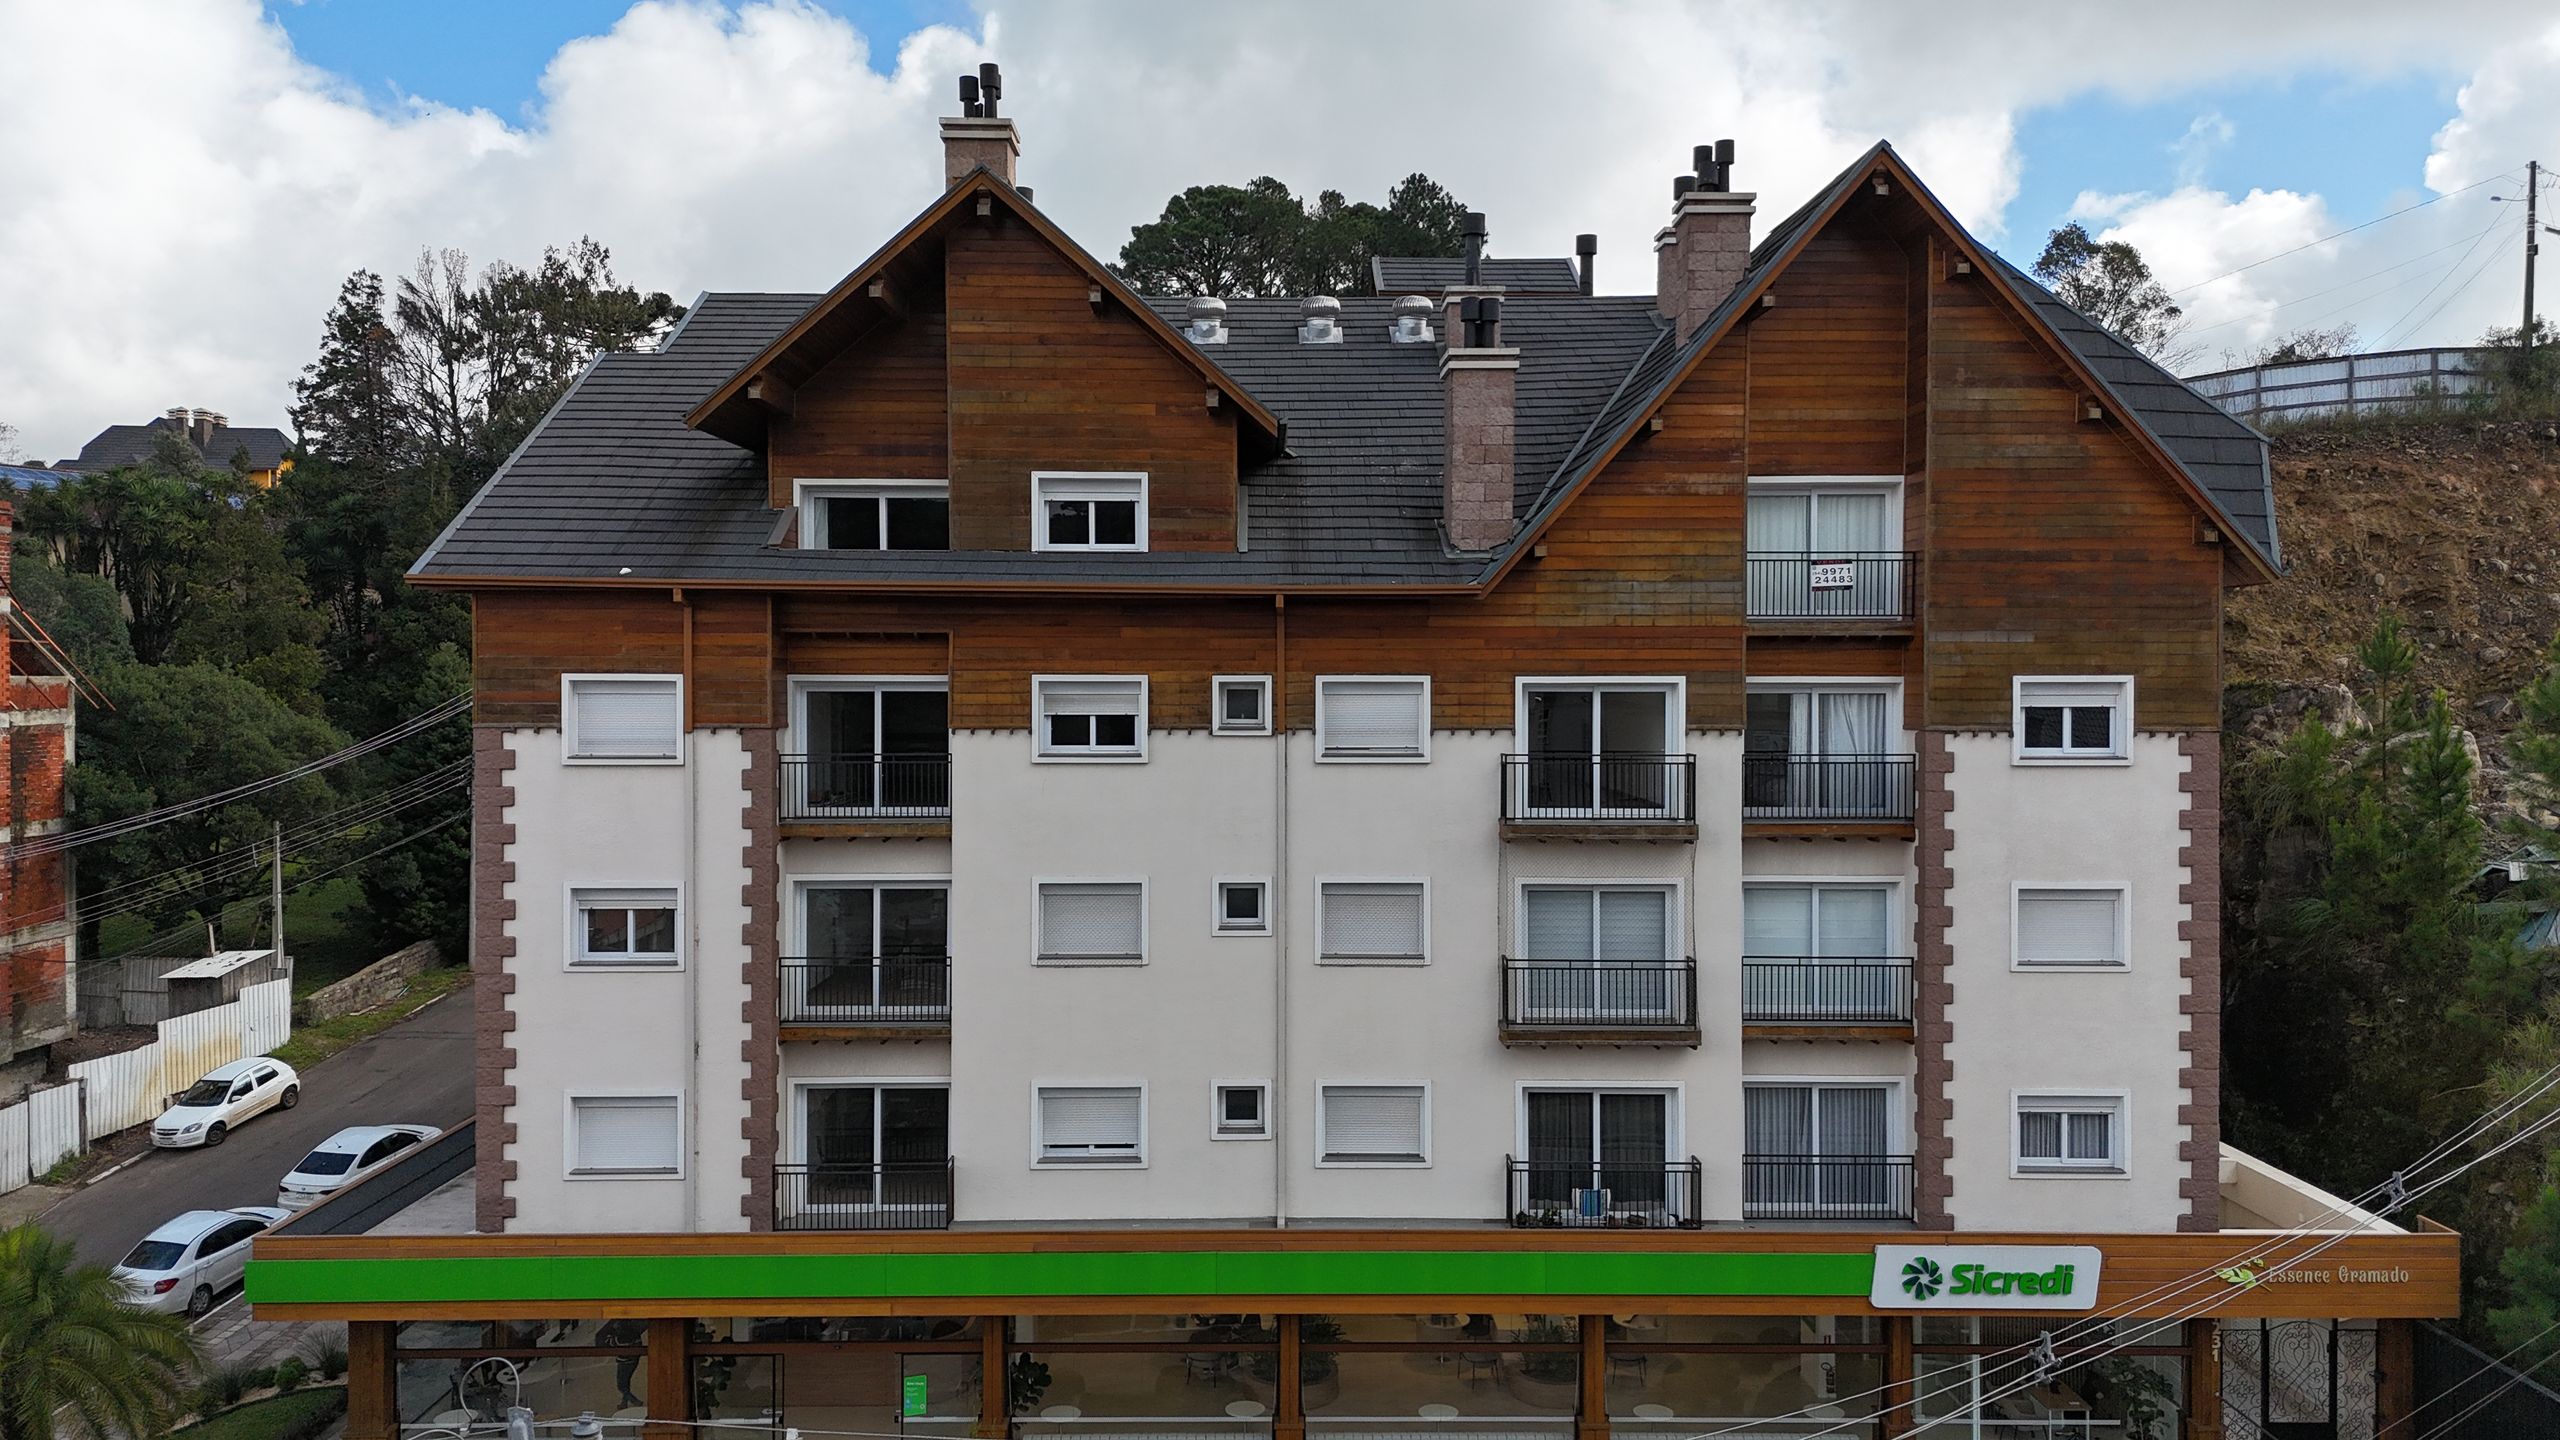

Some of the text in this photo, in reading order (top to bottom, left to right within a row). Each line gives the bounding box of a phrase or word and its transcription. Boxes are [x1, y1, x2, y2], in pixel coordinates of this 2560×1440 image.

[1815, 575, 1853, 584] 24483
[1821, 567, 1851, 575] 9971
[1949, 1264, 2074, 1296] Sicredi
[2269, 1265, 2409, 1283] Essence Gramado
[2211, 1318, 2221, 1362] 231
